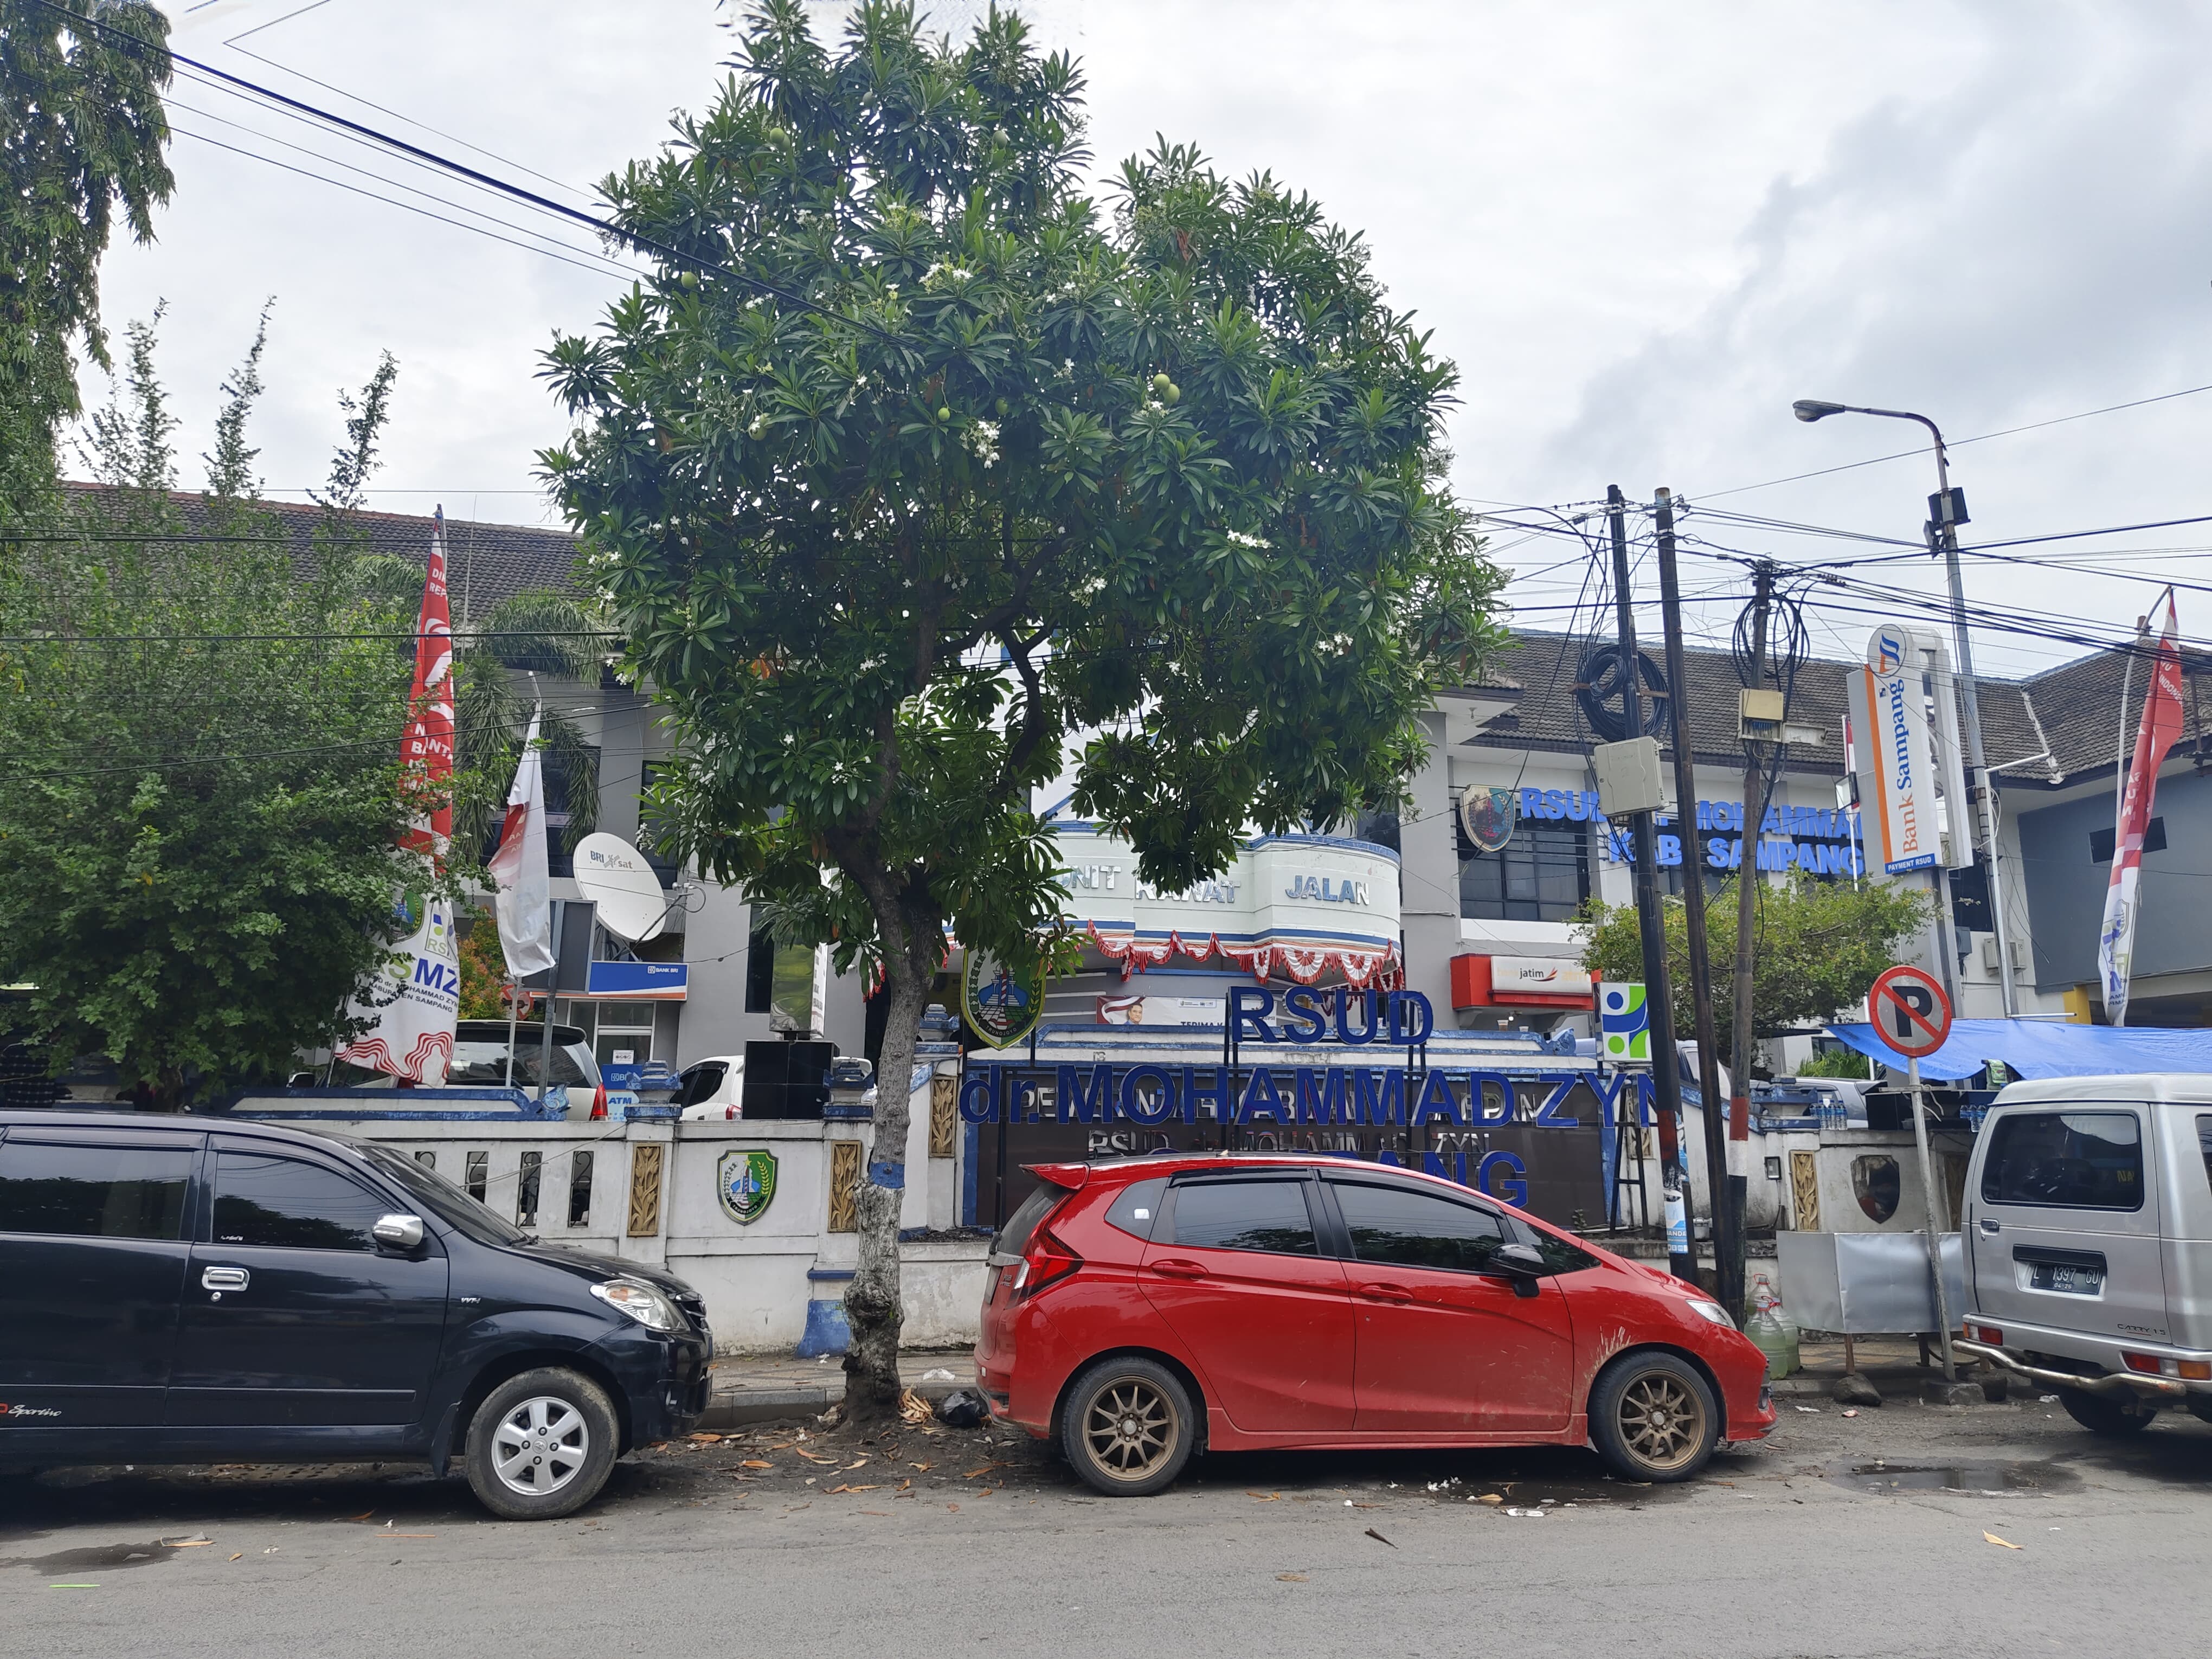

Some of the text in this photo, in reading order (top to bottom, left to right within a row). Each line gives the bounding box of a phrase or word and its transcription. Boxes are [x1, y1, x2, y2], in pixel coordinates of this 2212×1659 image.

[1889, 678, 1919, 855] Bank Sampang
[590, 850, 634, 869] BRI sat
[1888, 856, 1932, 872] PAYMENT RSUD
[1284, 874, 1370, 906] JALAN
[1519, 968, 1544, 979] jatim
[415, 995, 453, 1013] SAMPANG
[1892, 986, 1933, 1037] P
[1229, 986, 1434, 1045] RSUD
[985, 1025, 1018, 1037] TRUNOJOYO
[2033, 1264, 2100, 1284] L 1397 GU
[2117, 1323, 2151, 1333] CARRY
